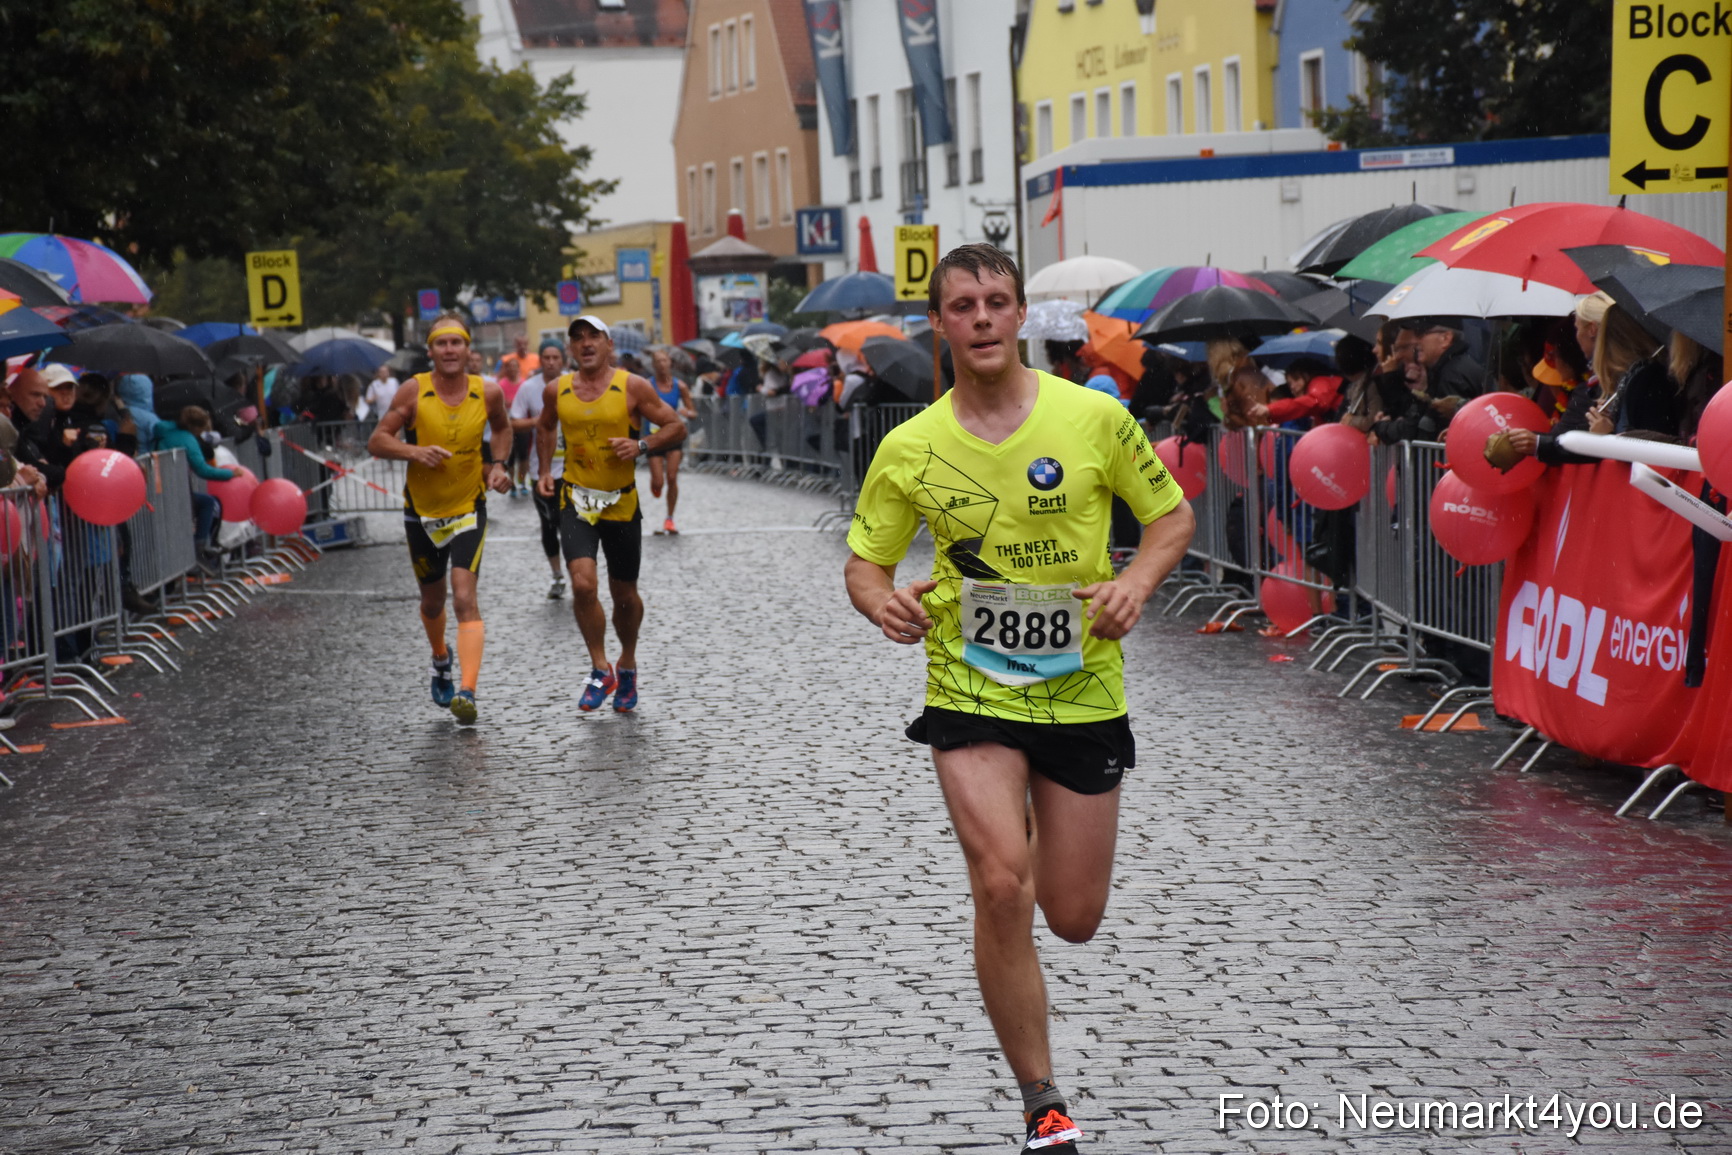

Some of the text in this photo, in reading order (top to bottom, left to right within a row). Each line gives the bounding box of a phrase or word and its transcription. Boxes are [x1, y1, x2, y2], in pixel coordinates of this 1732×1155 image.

[1629, 2, 1732, 39] Block
[1644, 54, 1712, 151] C
[900, 228, 935, 241] Block
[253, 254, 291, 269] Block
[906, 248, 928, 283] D
[262, 274, 287, 310] D
[1027, 493, 1067, 509] Partl
[1029, 507, 1067, 516] Neumarkt
[994, 539, 1058, 558] THE NEXT
[1010, 549, 1079, 569] 100 YEARS
[970, 591, 1008, 602] NeuerMarkt
[973, 606, 1072, 650] 2888
[1007, 659, 1038, 673] Max
